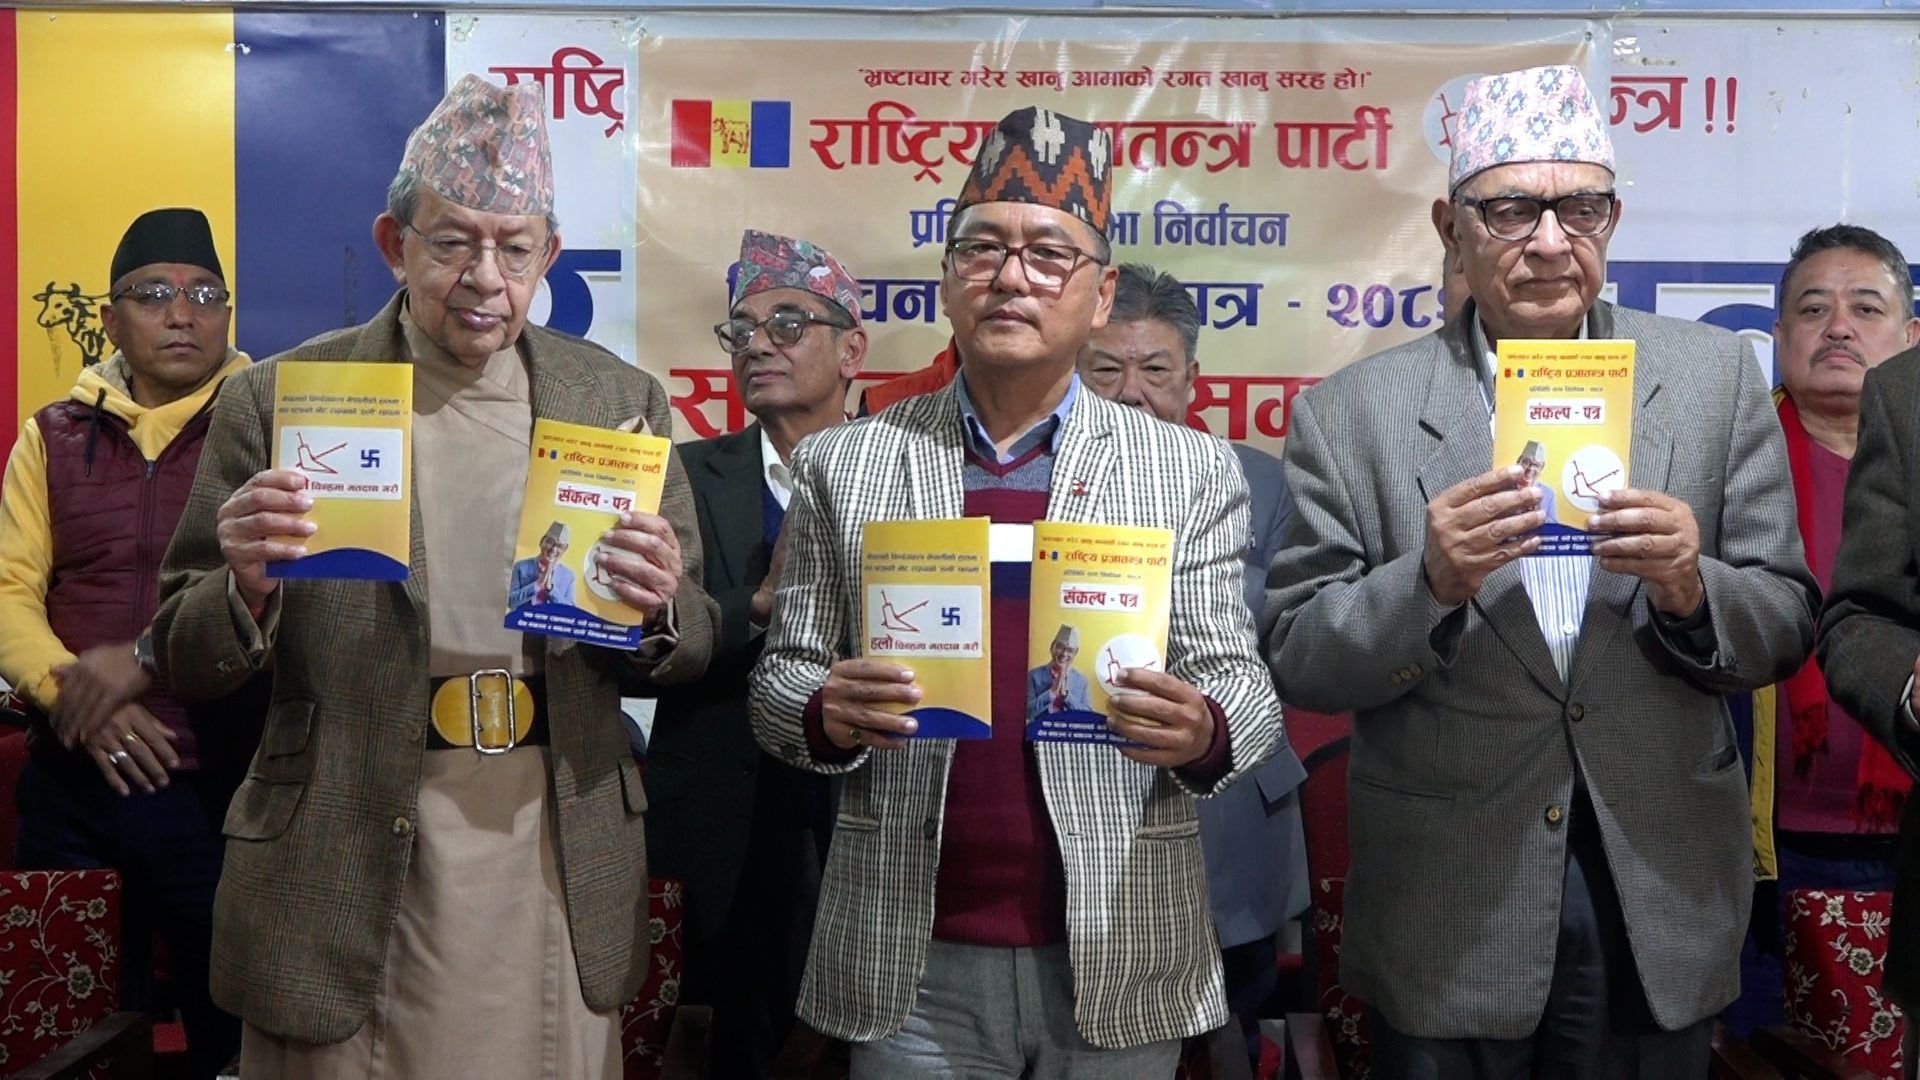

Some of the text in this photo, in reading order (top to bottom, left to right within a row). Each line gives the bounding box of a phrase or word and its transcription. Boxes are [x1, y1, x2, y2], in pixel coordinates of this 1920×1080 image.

[960, 65, 1009, 88] गरेर
[1016, 69, 1064, 91] खानु
[1072, 66, 1153, 88] आमाको
[1162, 71, 1213, 88] रगत
[1220, 70, 1269, 91] खानु
[1276, 71, 1326, 89] सरह
[1274, 105, 1393, 171] पार्टी
[1154, 200, 1290, 247] निर्वाचन
[1529, 402, 1572, 420] संकल्प
[1583, 405, 1602, 420] पत्र
[558, 485, 602, 508] संकल्प
[612, 495, 632, 512] पत्र
[1062, 586, 1107, 606] संकल्प
[1118, 592, 1139, 608] पत्र
